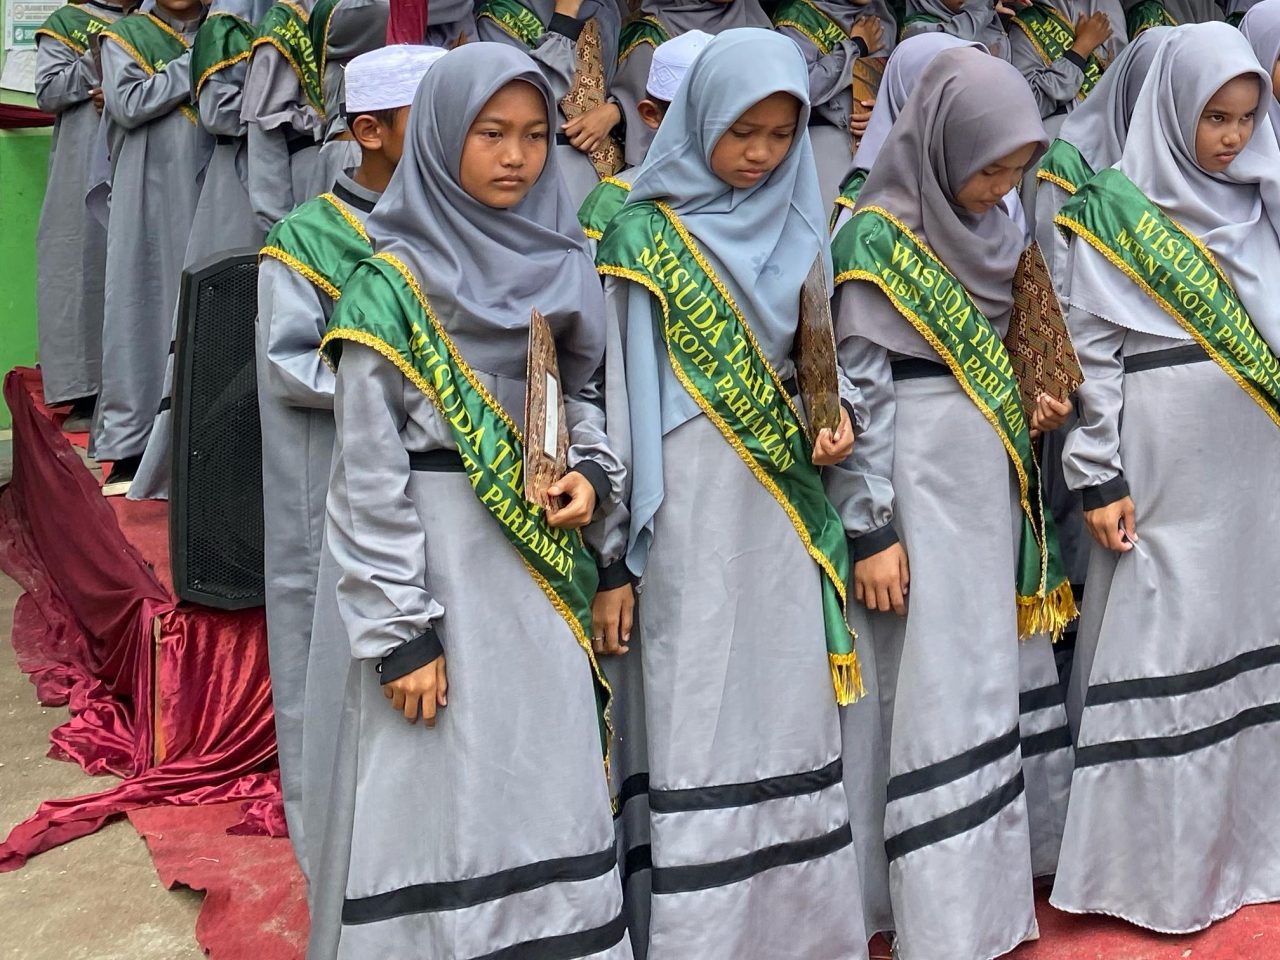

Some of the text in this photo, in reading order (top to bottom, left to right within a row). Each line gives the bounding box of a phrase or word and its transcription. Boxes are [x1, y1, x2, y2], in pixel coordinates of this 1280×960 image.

[1042, 16, 1074, 51] WISU
[891, 240, 971, 332] WISUDA
[1116, 227, 1163, 277] MTsN
[1159, 272, 1173, 286] 1
[1173, 282, 1218, 330] KOTA
[1134, 210, 1220, 302] WISUDA
[668, 319, 796, 474] KOTA PARIAMAN
[963, 354, 1028, 439] PARIAMAN
[480, 483, 576, 584] PARIAMAN
